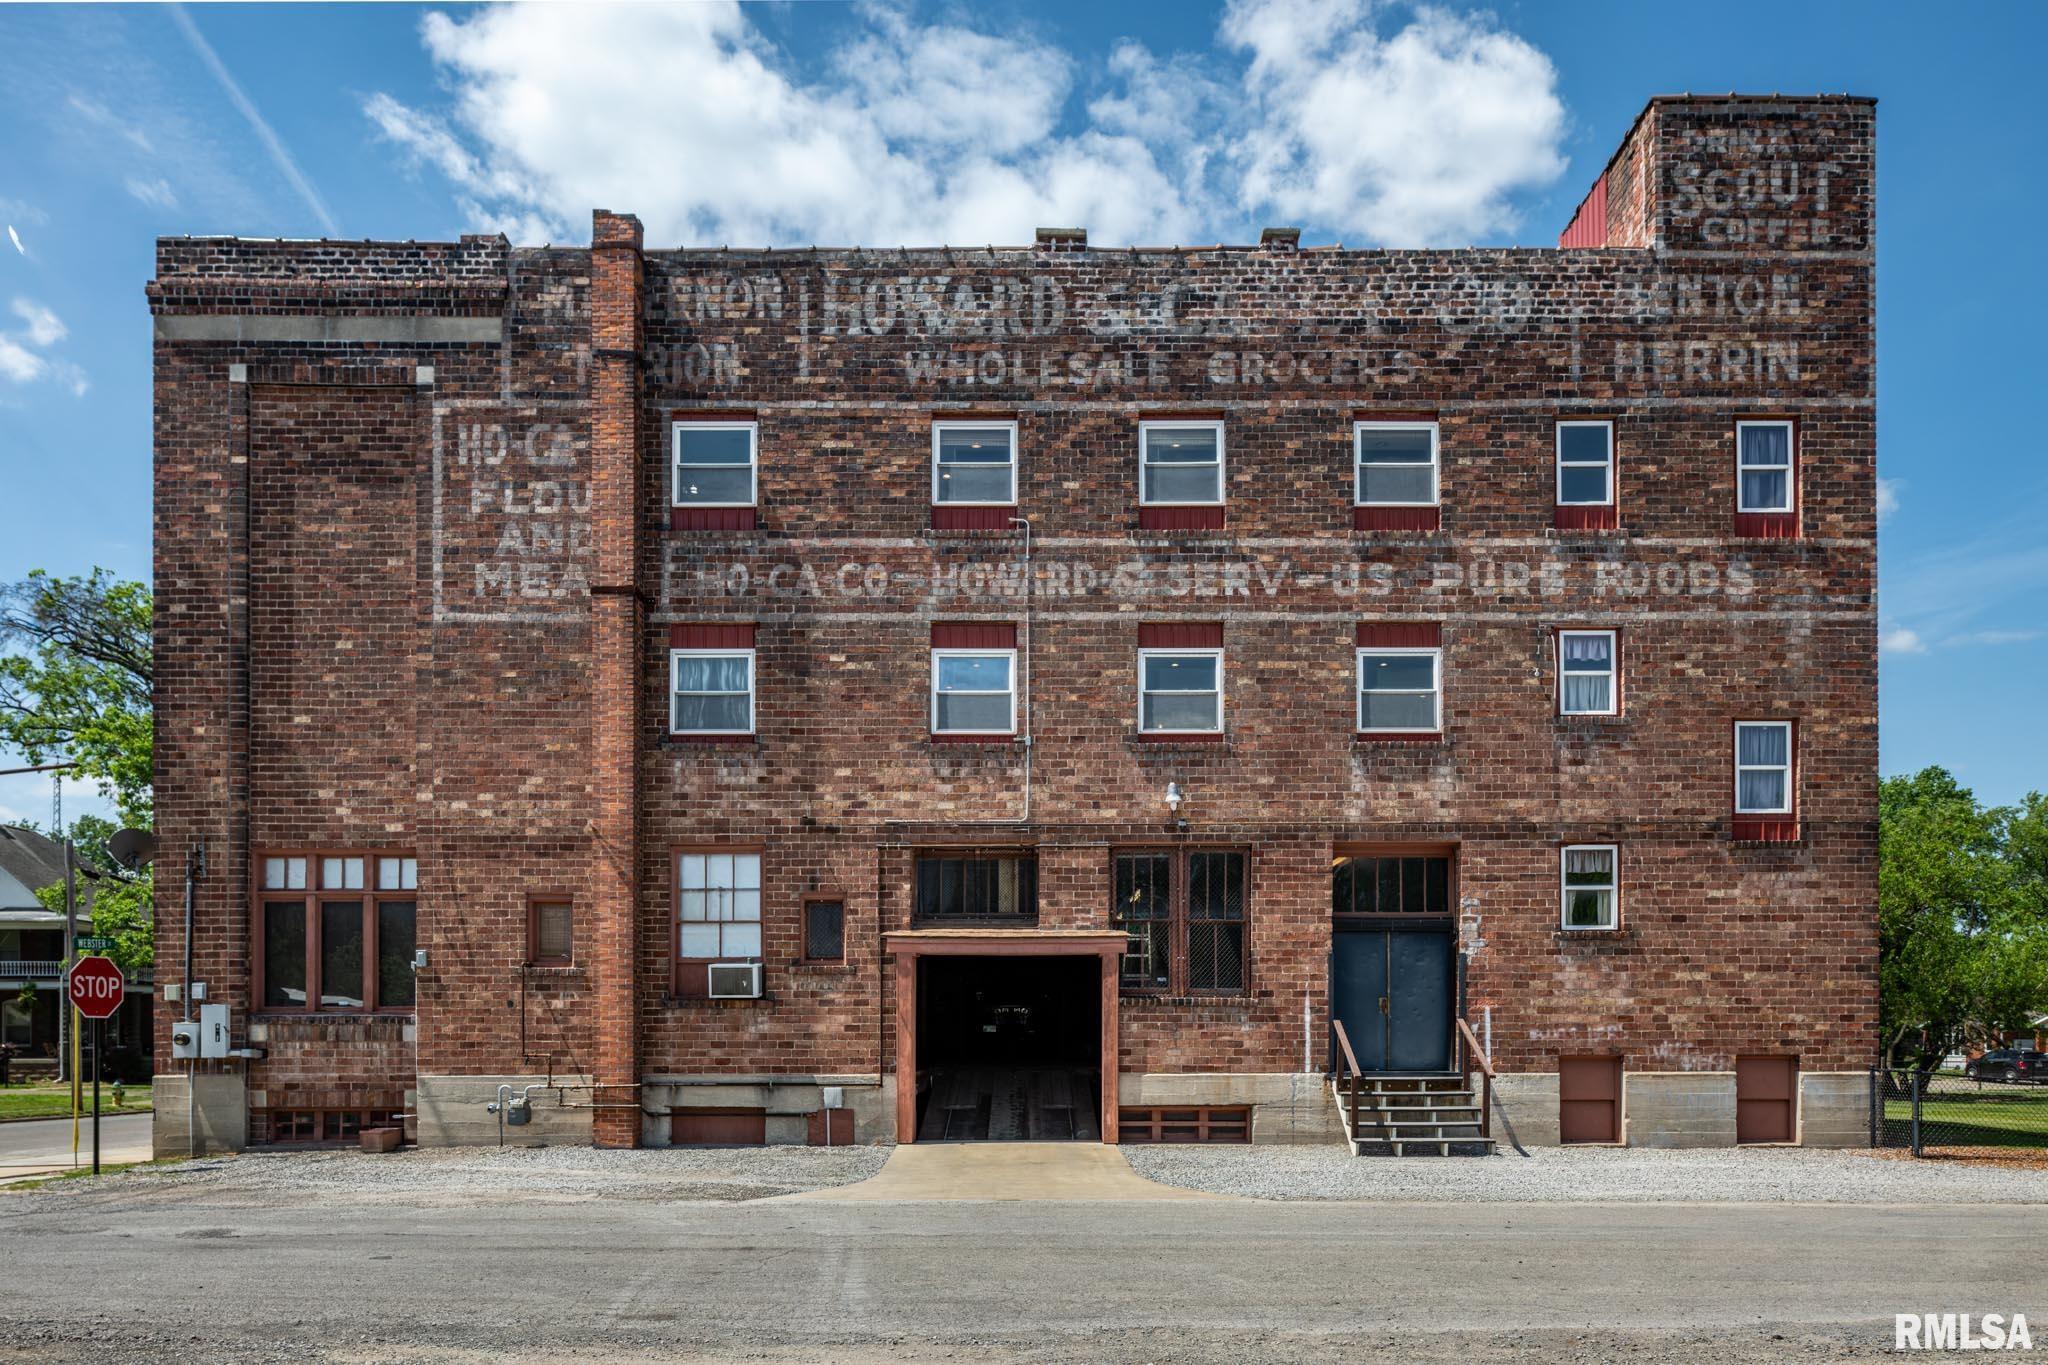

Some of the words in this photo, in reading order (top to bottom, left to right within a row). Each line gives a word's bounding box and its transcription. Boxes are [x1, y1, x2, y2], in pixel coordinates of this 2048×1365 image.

[1671, 161, 1843, 218] SCOUT
[905, 349, 1172, 387] WHOLESALE
[1206, 349, 1422, 388] GROCERS
[1614, 339, 1800, 382] HERRIN
[471, 482, 592, 514] FLOU
[474, 562, 592, 597] MEA
[1596, 560, 1756, 601] FOODS
[78, 938, 107, 949] WEBSTER
[73, 975, 120, 999] STOP
